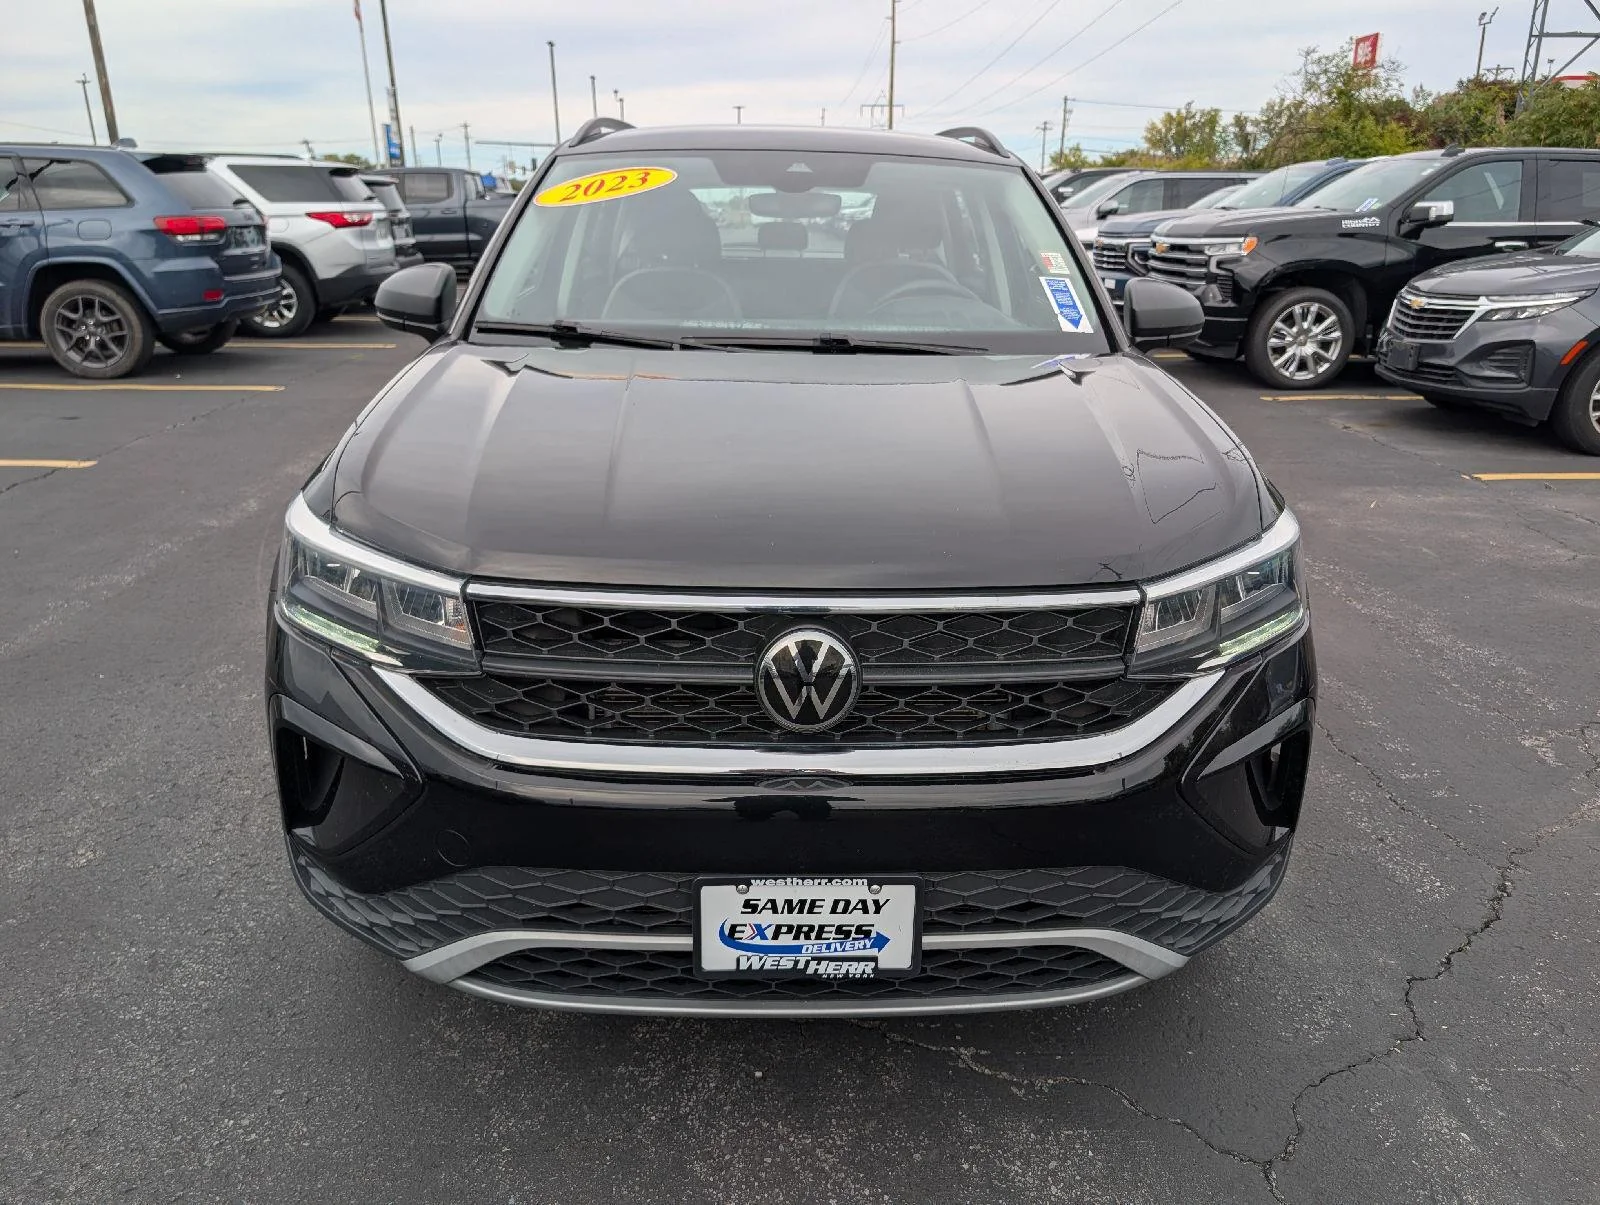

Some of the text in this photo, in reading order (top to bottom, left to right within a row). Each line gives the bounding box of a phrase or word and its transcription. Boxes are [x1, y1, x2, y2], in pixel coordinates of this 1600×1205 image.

[559, 171, 650, 202] 2023
[750, 877, 868, 887] westherr.com
[740, 898, 891, 915] SAME DAY
[727, 923, 875, 941] EXPRESS
[801, 939, 874, 954] DELIVERY
